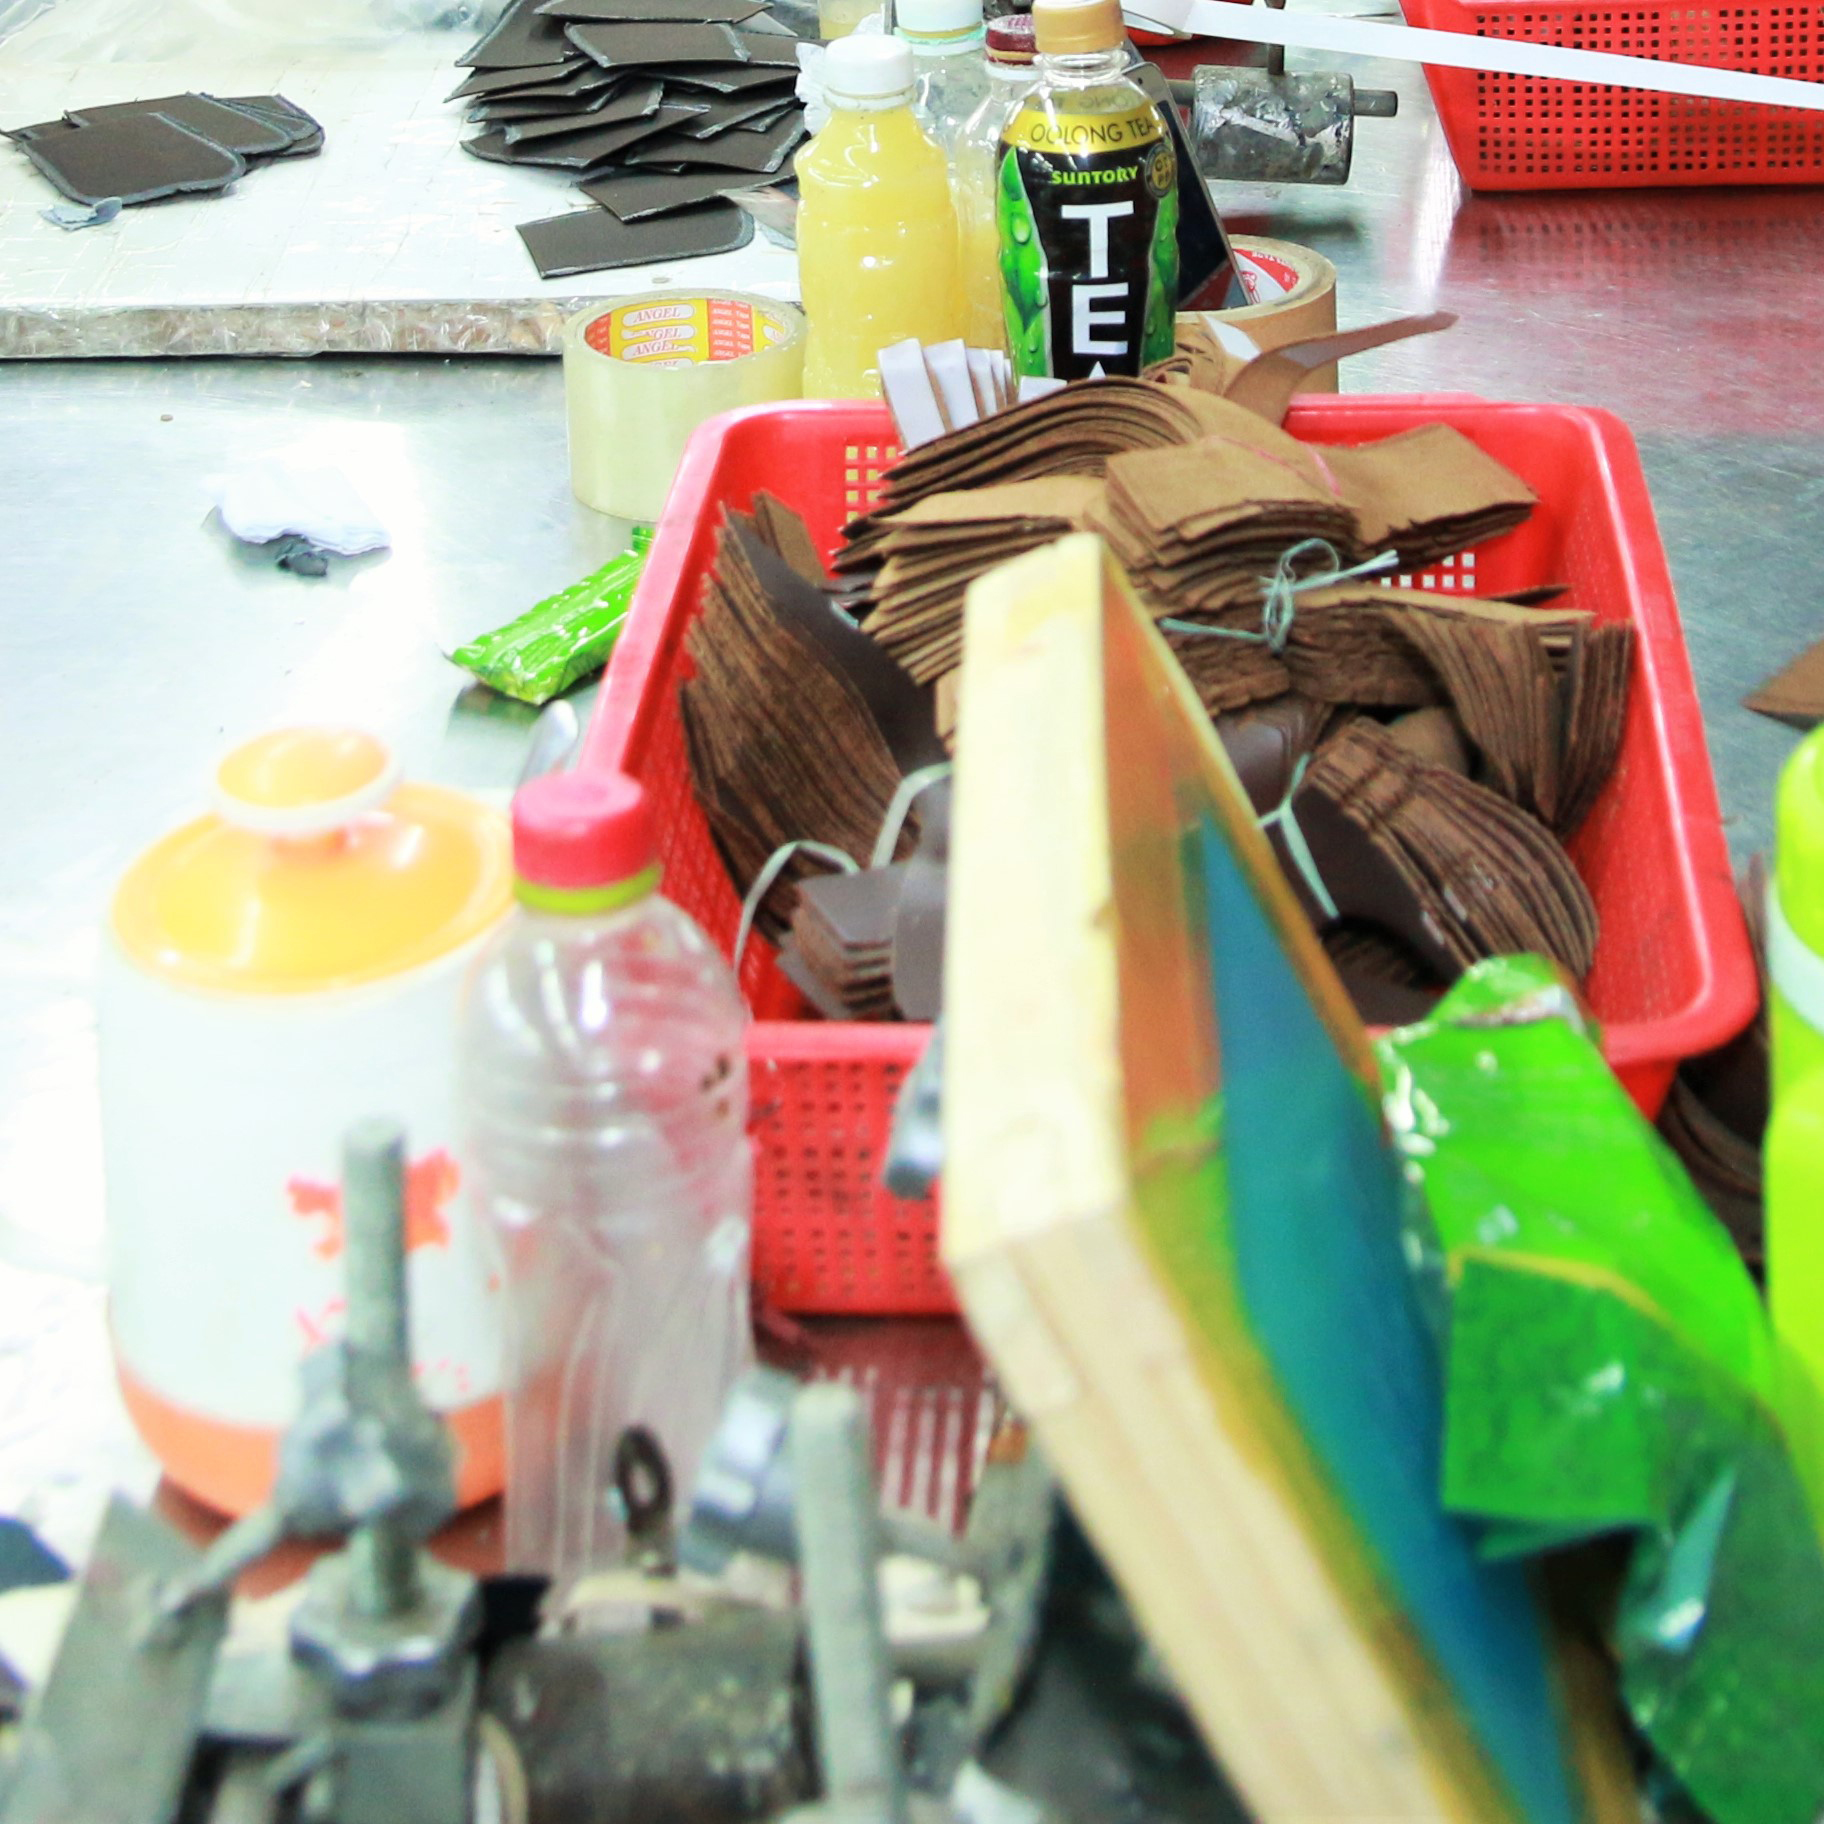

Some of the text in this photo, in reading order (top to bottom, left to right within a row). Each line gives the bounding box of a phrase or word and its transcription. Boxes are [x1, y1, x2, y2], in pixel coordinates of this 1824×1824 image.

[1030, 117, 1154, 145] OOLONG TEA
[1060, 201, 1134, 379] TE
[633, 307, 681, 323] ANGEL
